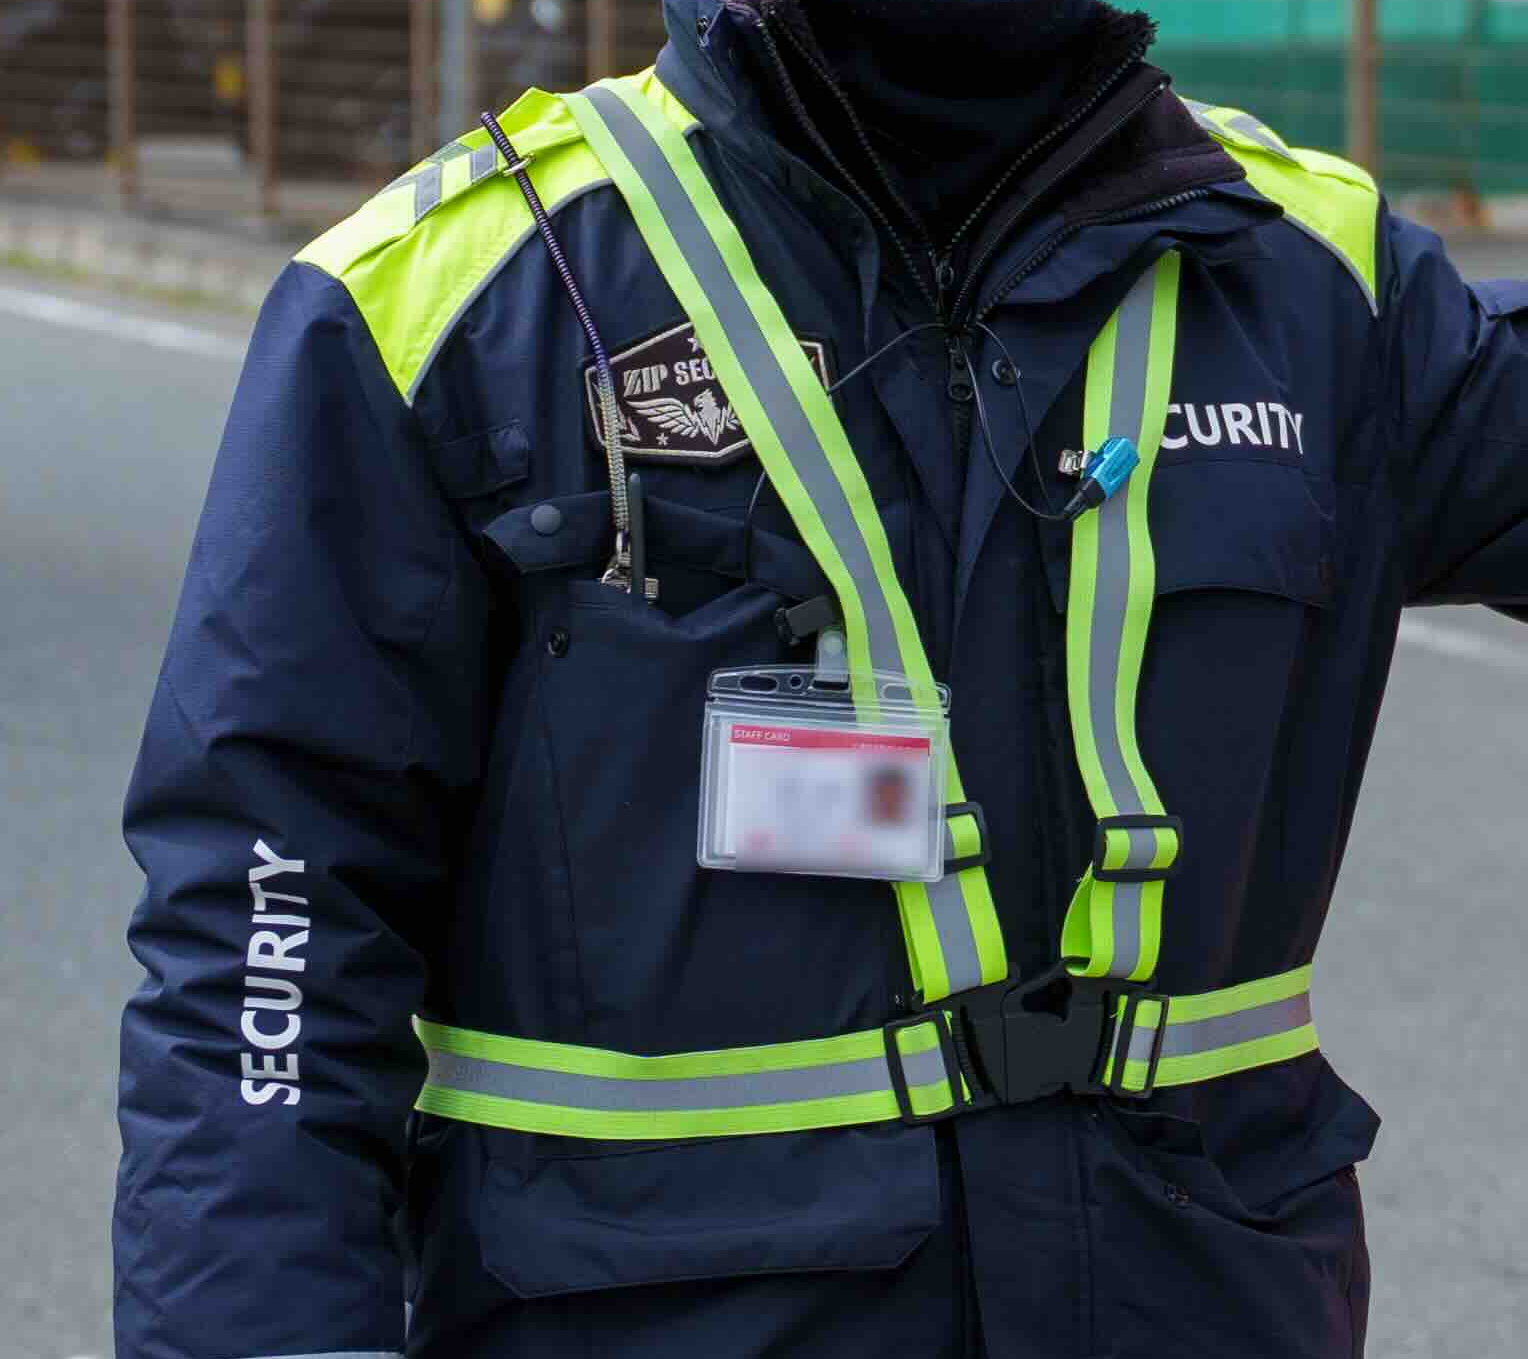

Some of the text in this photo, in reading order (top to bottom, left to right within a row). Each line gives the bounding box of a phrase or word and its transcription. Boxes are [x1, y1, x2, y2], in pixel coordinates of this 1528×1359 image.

[624, 363, 669, 398] ZIP
[1160, 401, 1304, 455] CURITY
[240, 838, 311, 1106] SECURITY
